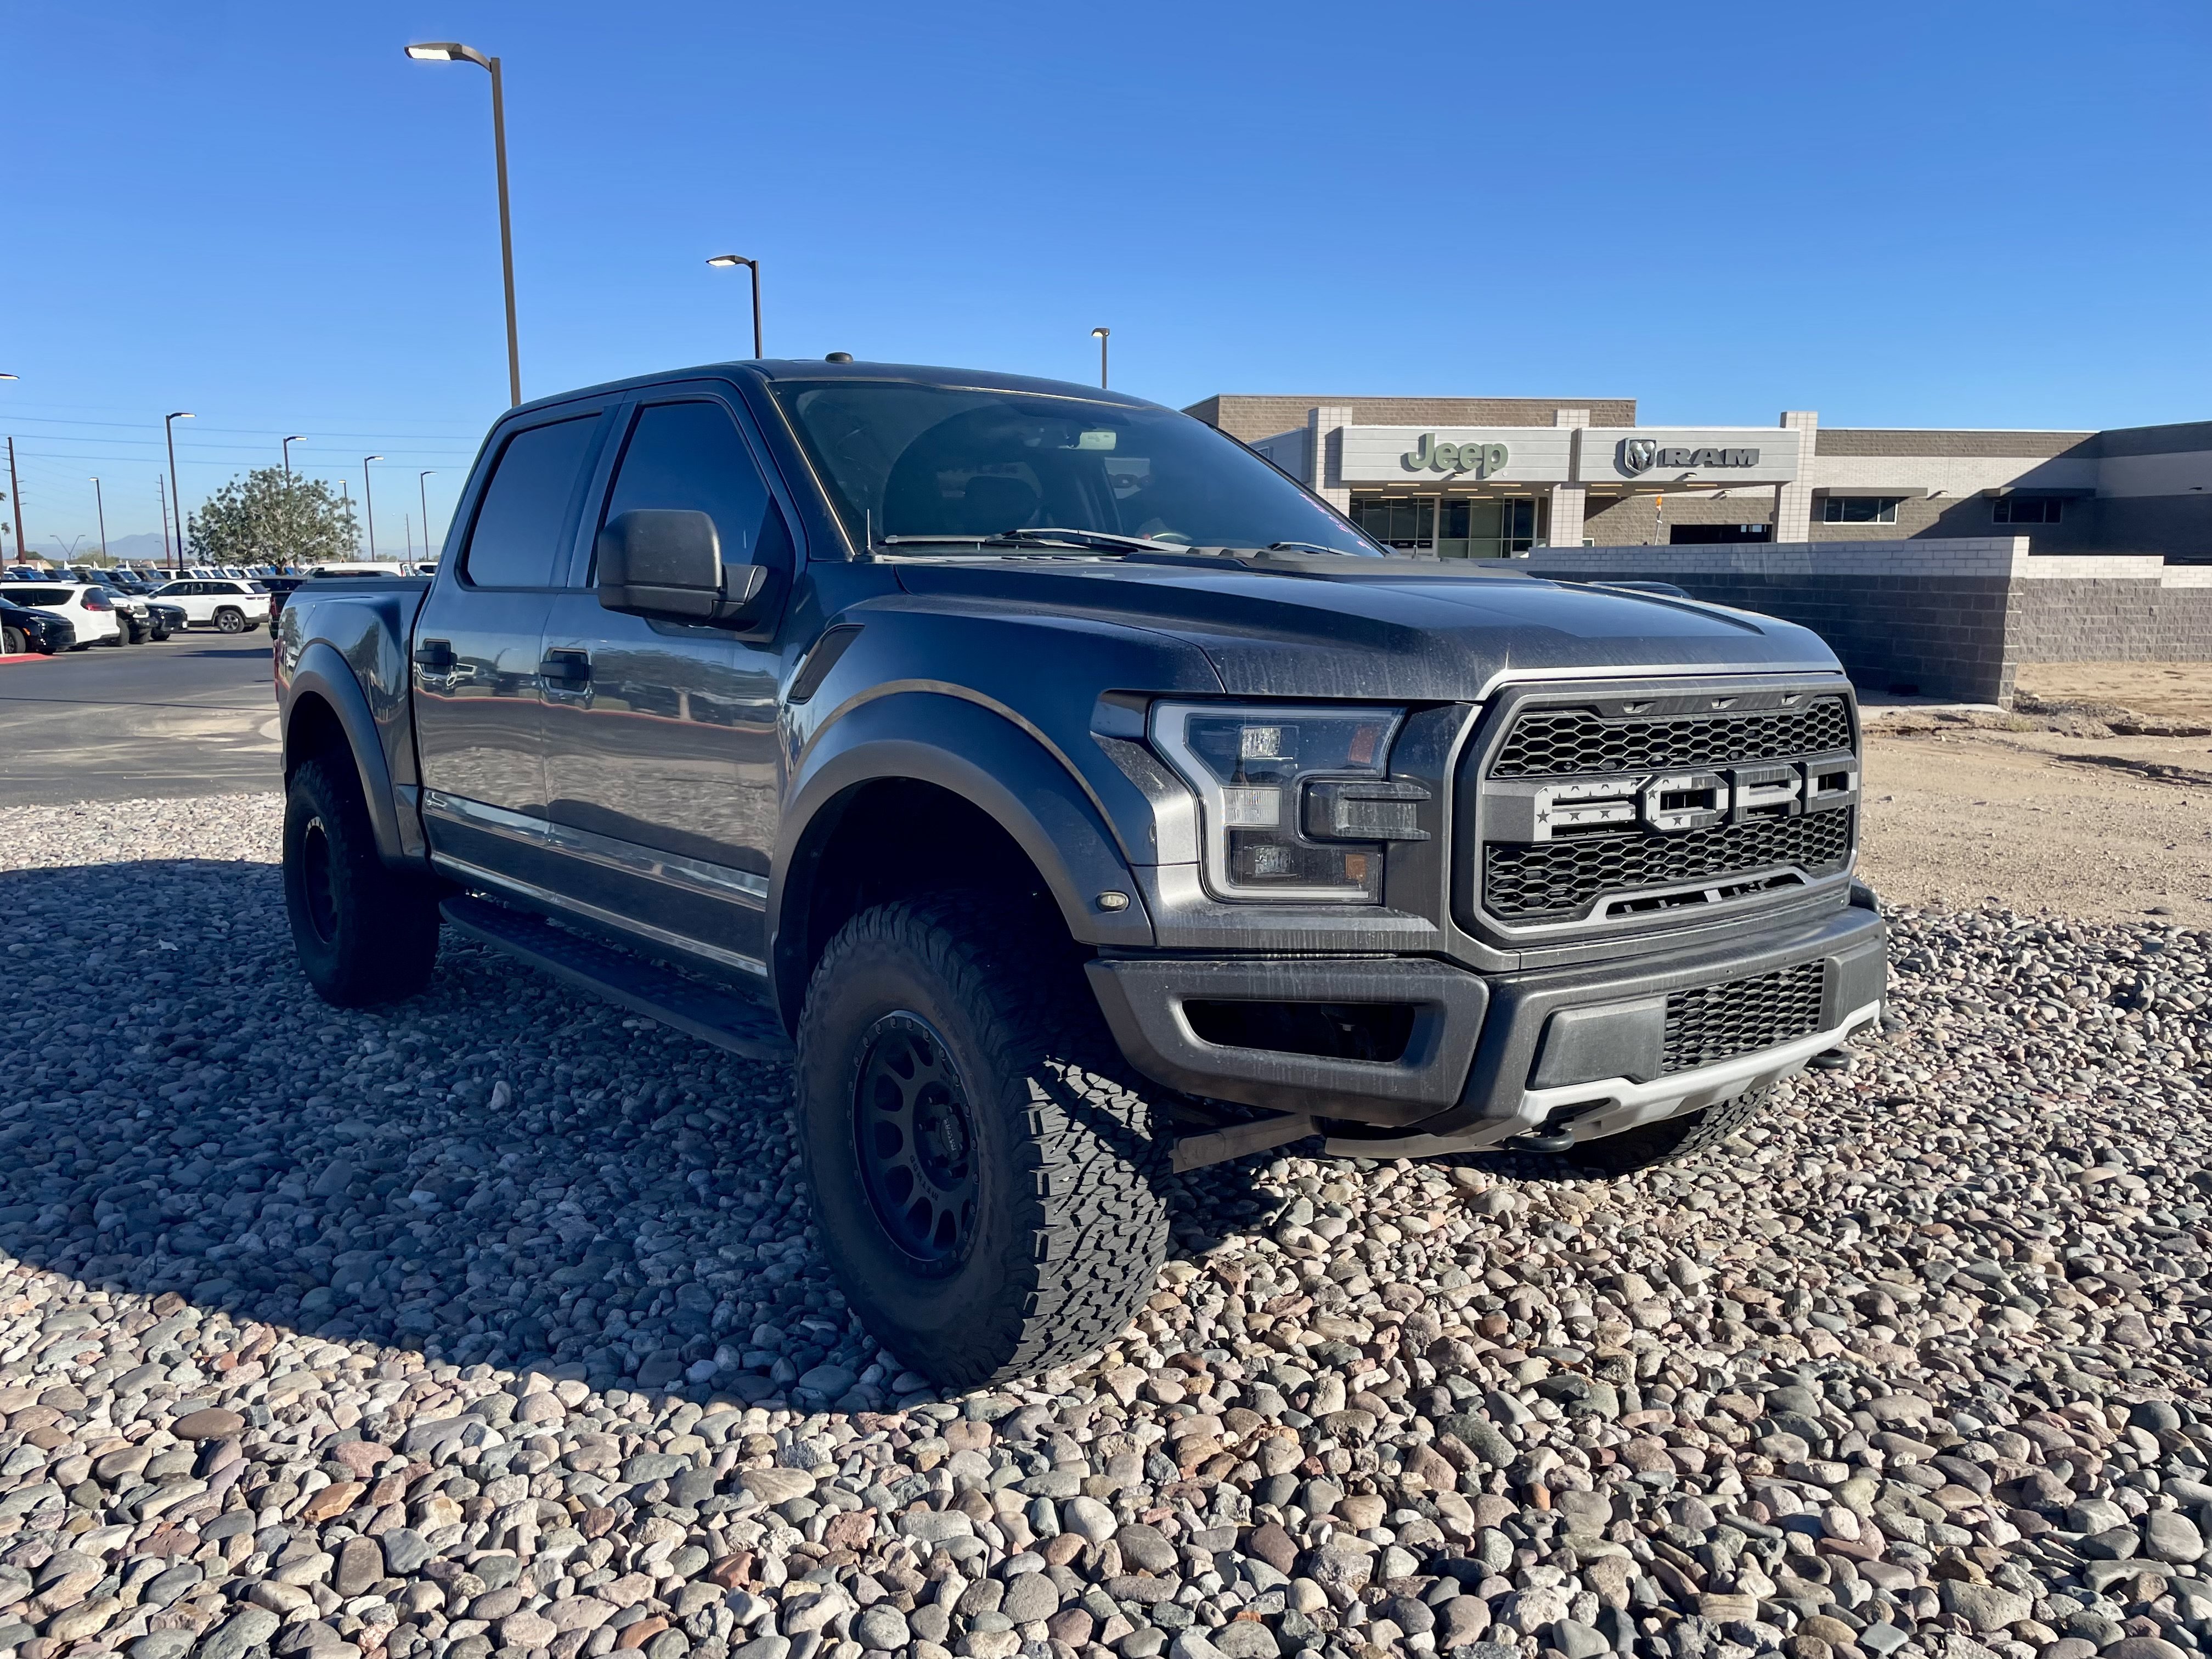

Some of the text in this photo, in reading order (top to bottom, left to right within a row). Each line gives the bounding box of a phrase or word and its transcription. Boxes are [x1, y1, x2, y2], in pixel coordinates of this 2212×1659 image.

[1404, 433, 1508, 477] Jeep
[1661, 448, 1760, 465] RAM
[1534, 752, 1858, 843] FORD
